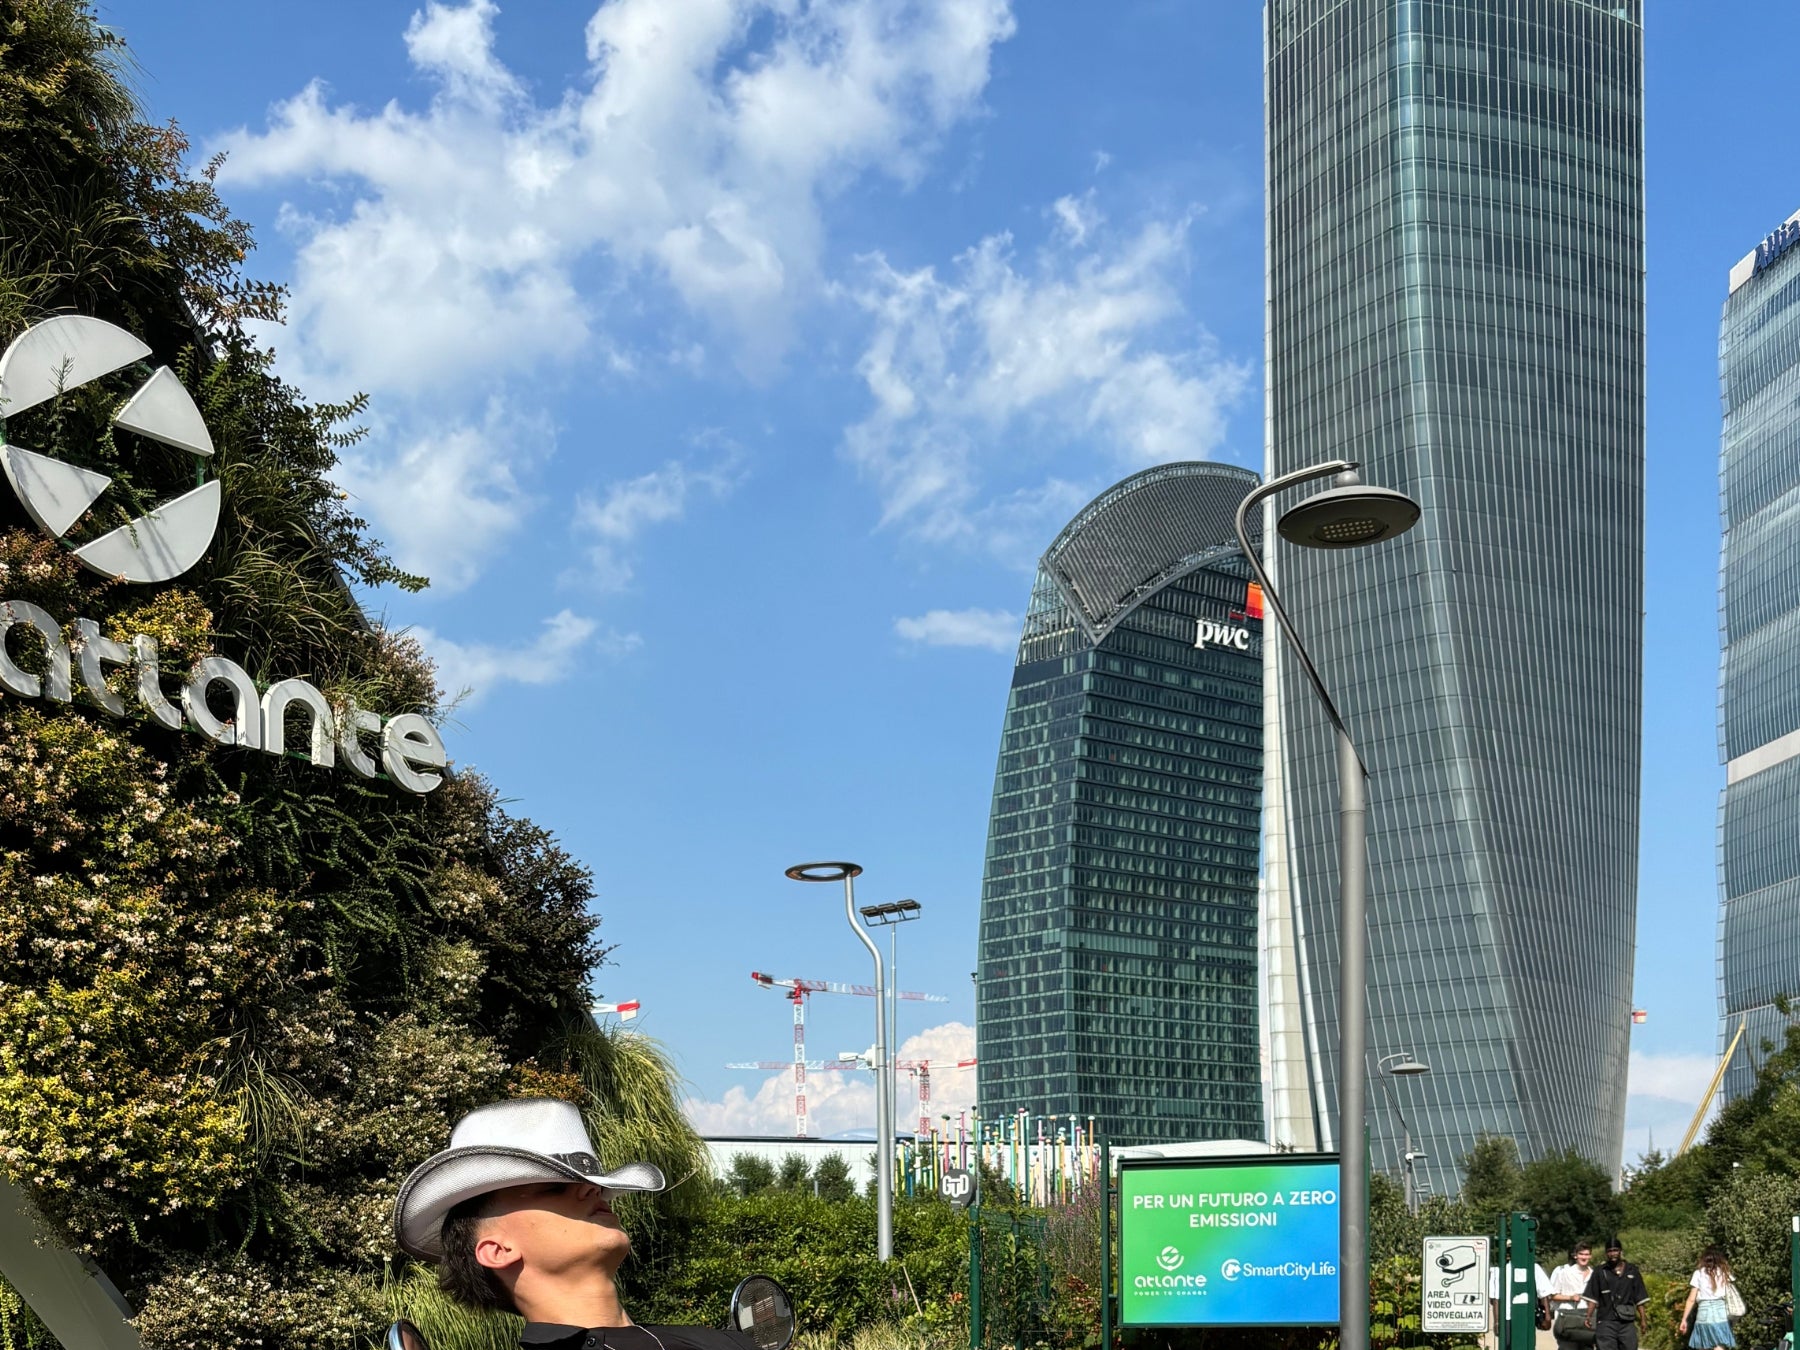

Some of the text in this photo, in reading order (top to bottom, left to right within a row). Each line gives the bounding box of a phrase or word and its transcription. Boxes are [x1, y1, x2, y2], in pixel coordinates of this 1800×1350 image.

[1194, 619, 1249, 650] pwc
[0, 600, 447, 793] atlante
[1133, 1190, 1337, 1209] PER UN FUTURO A ZERO
[1189, 1212, 1277, 1228] EMISSIONI
[1243, 1261, 1336, 1281] SmartCityLife
[1134, 1274, 1207, 1288] atlante
[1427, 1290, 1450, 1299] AREA
[1427, 1301, 1452, 1309] VIDEO
[1427, 1310, 1483, 1319] SORVEGLIATA
